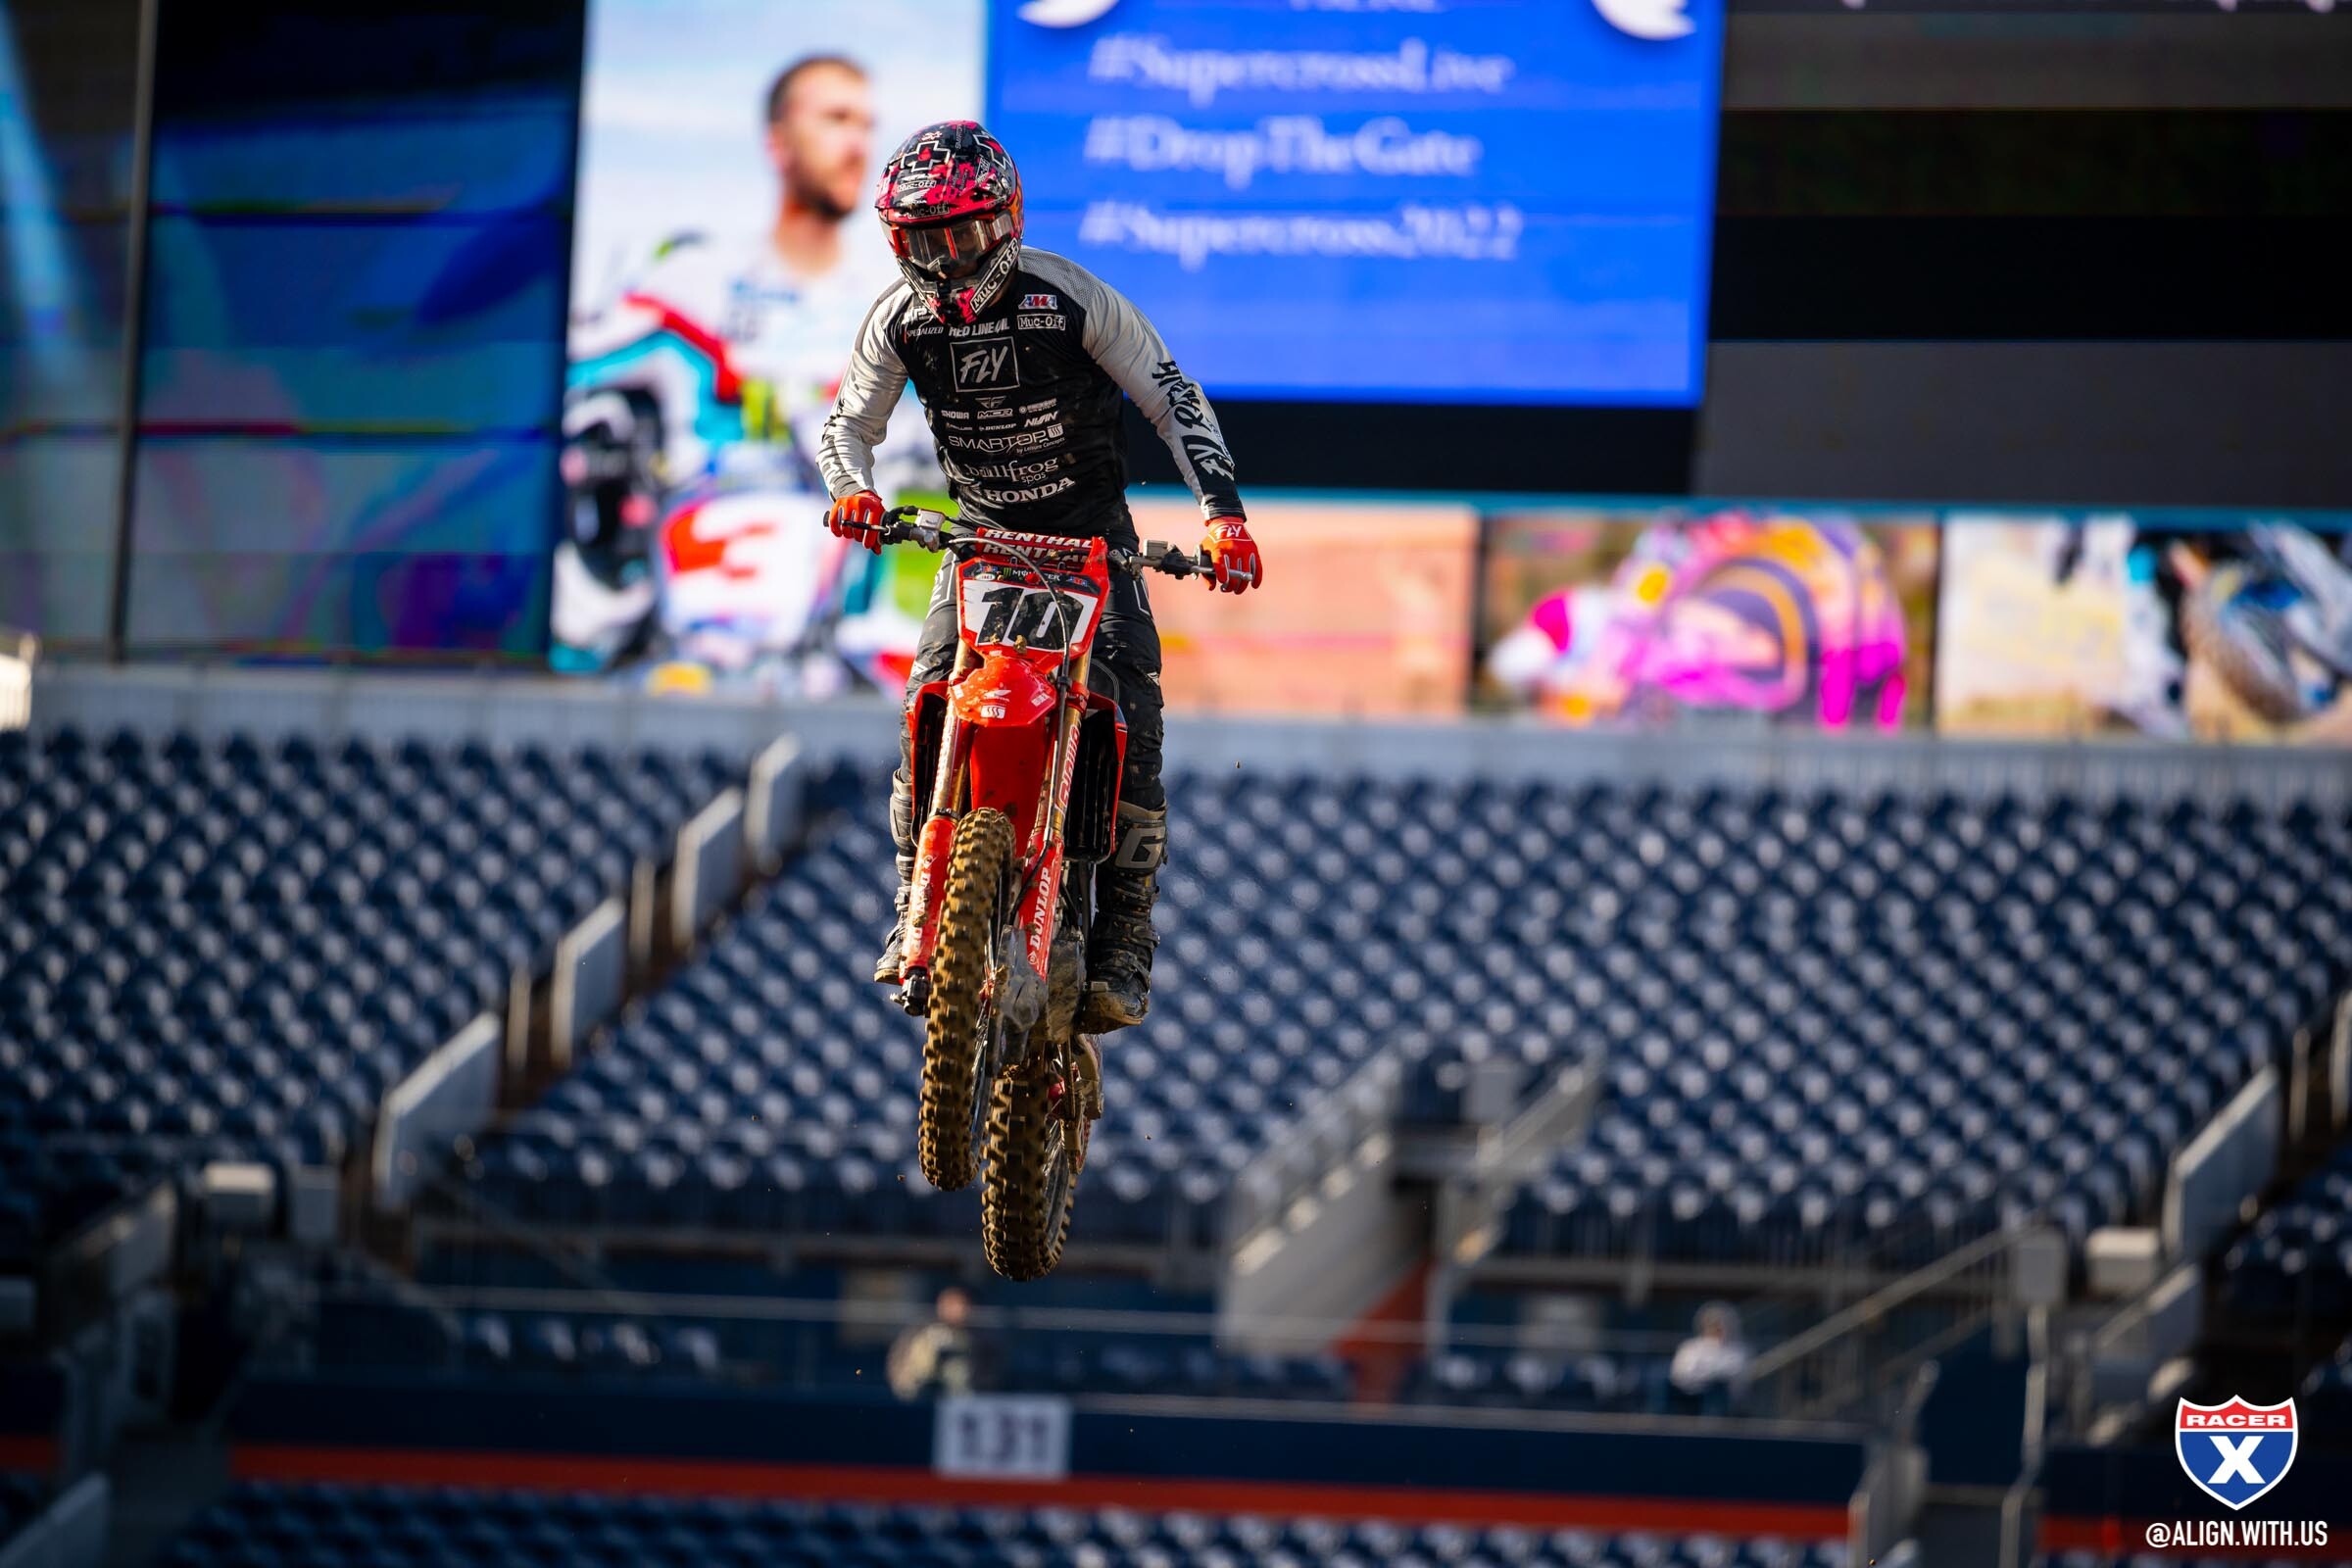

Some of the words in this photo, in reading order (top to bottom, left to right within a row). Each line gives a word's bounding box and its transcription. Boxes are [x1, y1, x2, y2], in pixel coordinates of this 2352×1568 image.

[1085, 115, 1481, 189] #DropTheGate
[910, 203, 947, 217] uc-Off
[973, 239, 1019, 308] Muc-Off
[1019, 294, 1057, 310] AMA
[949, 326, 969, 337] RED
[972, 321, 995, 335] LINE
[995, 318, 1009, 333] OIL
[1020, 316, 1063, 330] Muc-Off
[959, 345, 1008, 384] FLY
[941, 410, 969, 419] SHOWA
[948, 429, 1047, 451] SMARTOP
[1043, 437, 1065, 448] Concepts
[964, 457, 1058, 482] bullfrog
[1021, 472, 1046, 485] spas
[984, 476, 1075, 503] HONDA
[984, 529, 1094, 549] RENTHAL
[1214, 524, 1242, 538] FLY
[1012, 569, 1060, 581] MOER
[977, 586, 1085, 651] 10
[1029, 866, 1050, 952] DUNLOP
